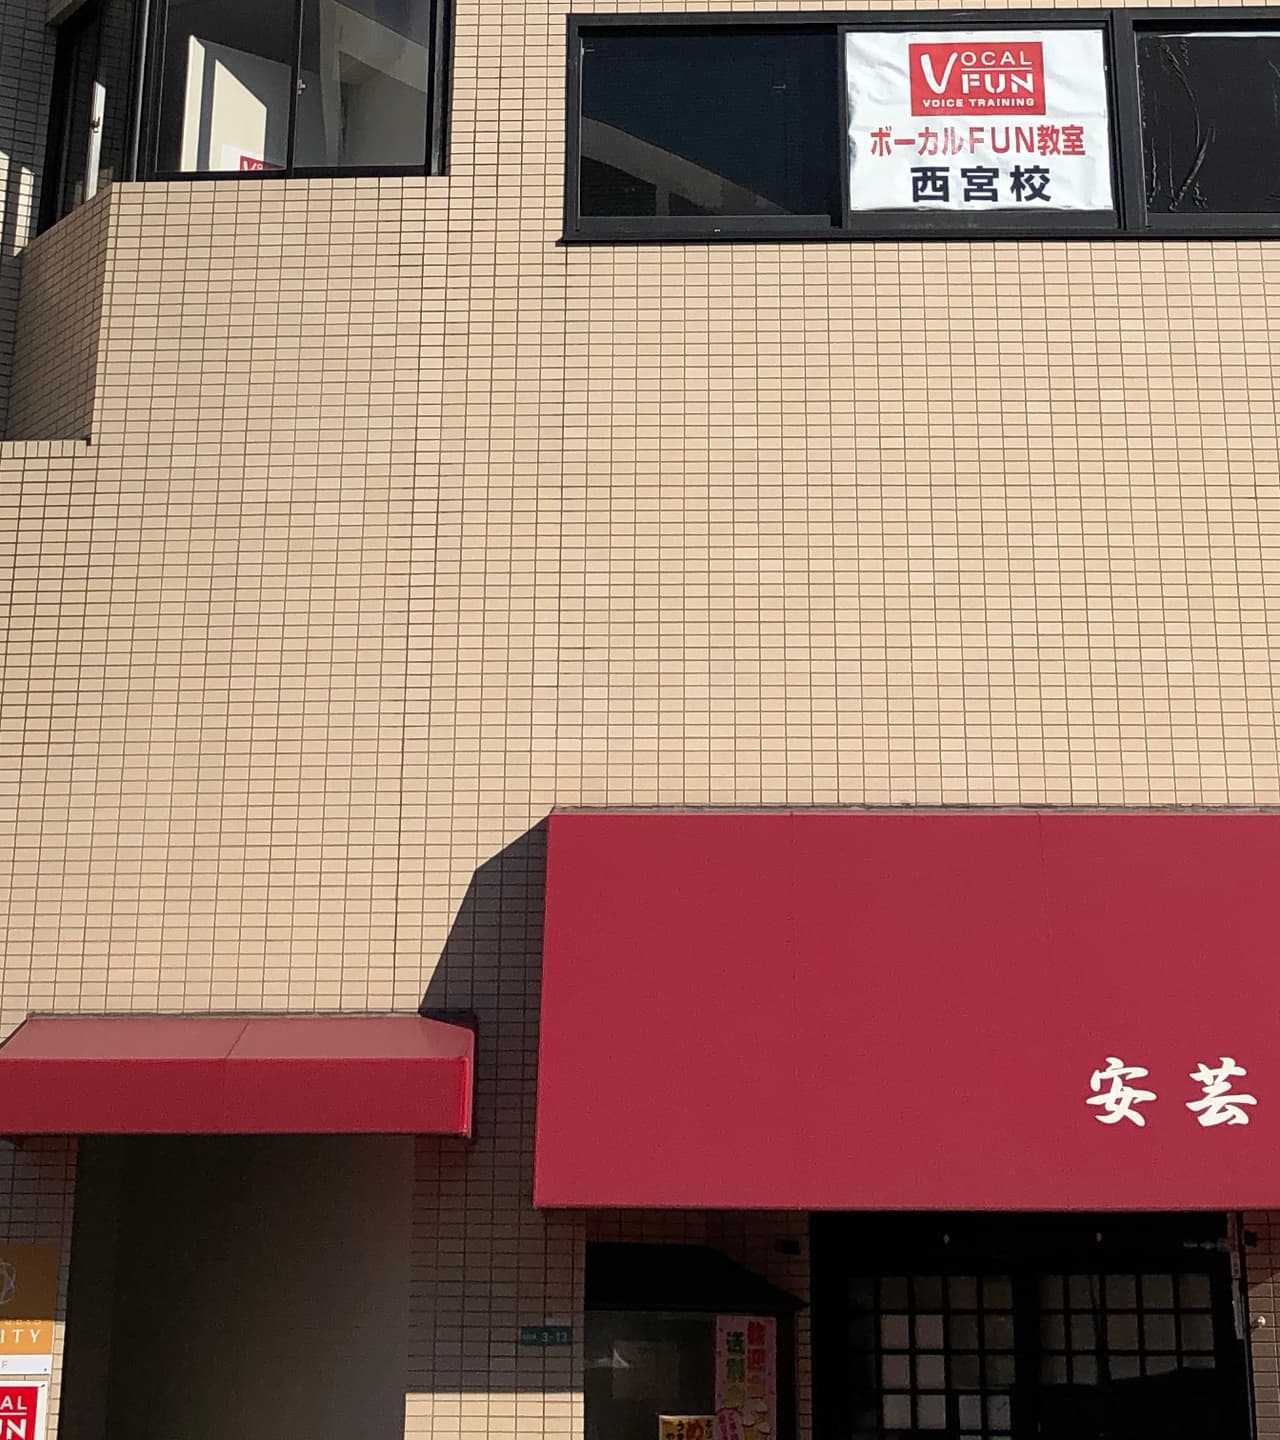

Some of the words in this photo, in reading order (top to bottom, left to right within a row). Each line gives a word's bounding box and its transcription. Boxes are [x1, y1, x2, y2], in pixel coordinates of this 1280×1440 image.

[921, 50, 1033, 94] VOCAL
[961, 73, 1034, 94] FUN
[922, 98, 964, 108] VOICE
[968, 97, 1035, 107] TRAINING
[870, 124, 1086, 157] ボーカルFUN教室
[910, 164, 1052, 202] 西宮校
[1086, 1057, 1258, 1127] 安芸
